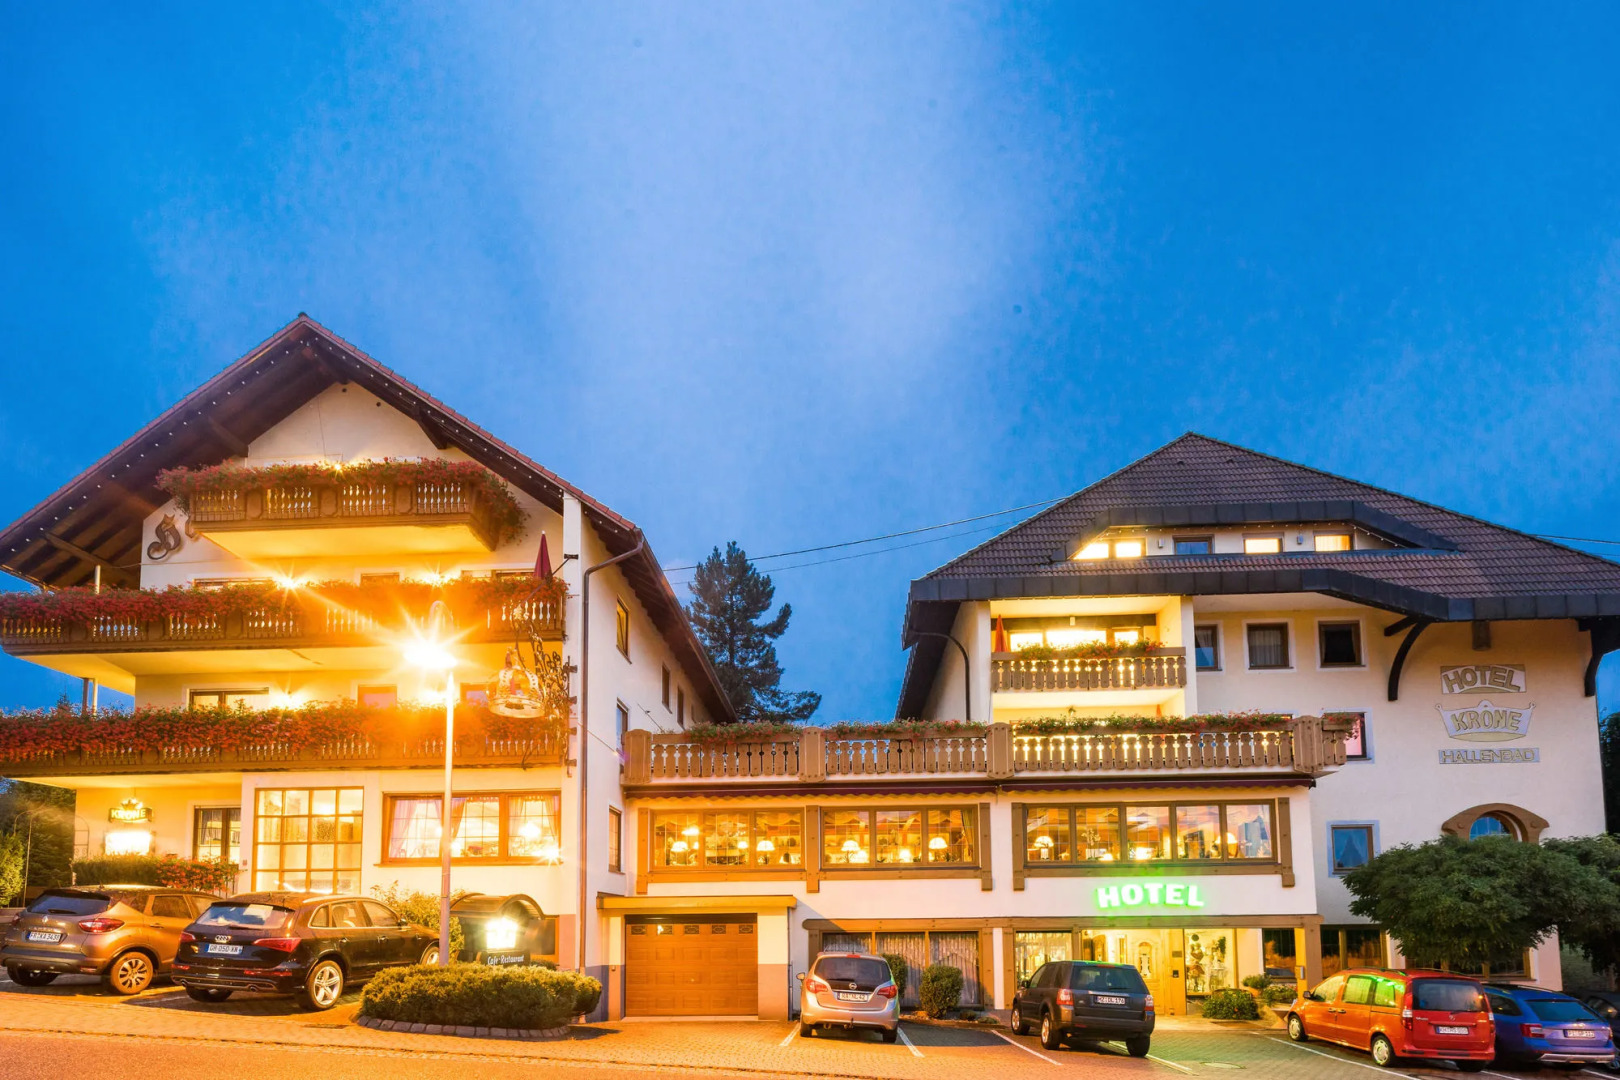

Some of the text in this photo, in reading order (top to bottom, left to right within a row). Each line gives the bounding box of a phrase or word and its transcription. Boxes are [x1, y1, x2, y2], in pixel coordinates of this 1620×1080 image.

[1443, 665, 1521, 693] HOTEL
[1451, 709, 1522, 731] KRONE
[1442, 749, 1535, 763] HALLENBAD
[111, 809, 146, 820] KRONE
[1096, 882, 1205, 908] HOTEL
